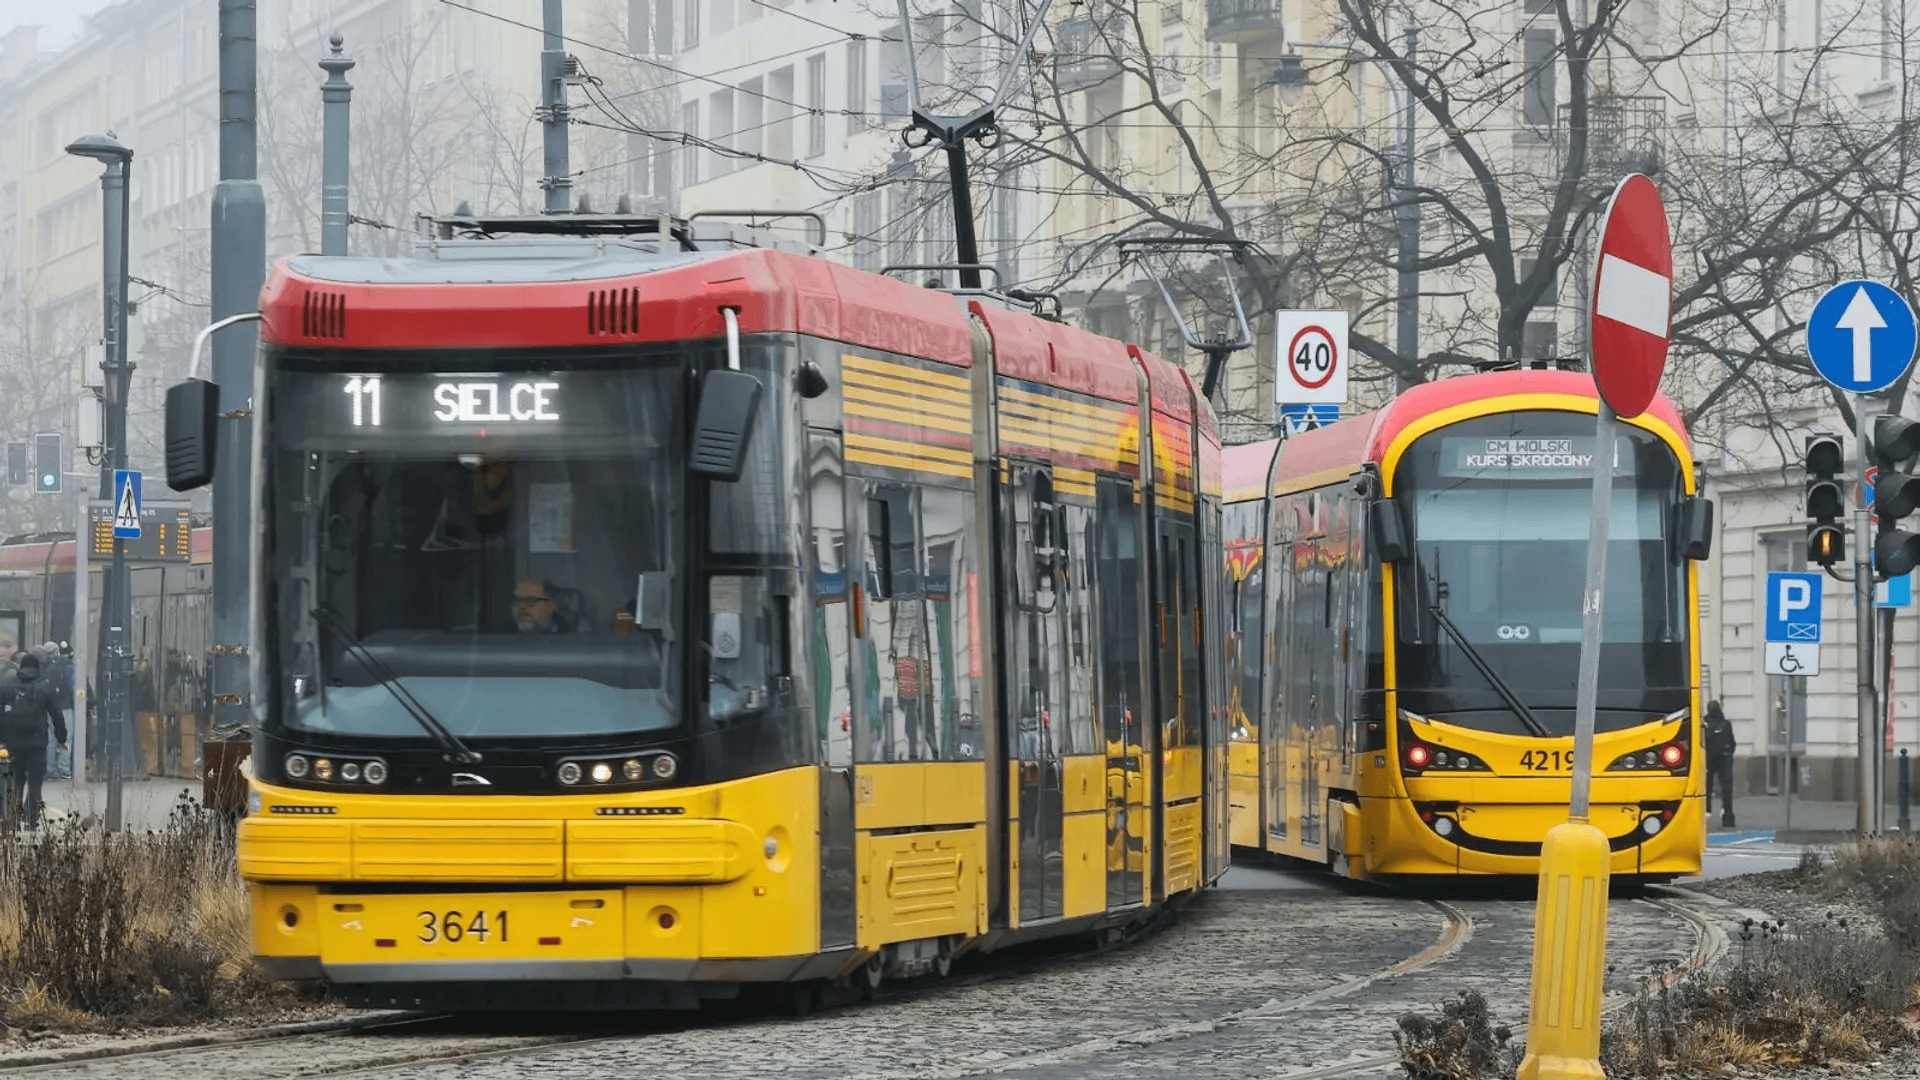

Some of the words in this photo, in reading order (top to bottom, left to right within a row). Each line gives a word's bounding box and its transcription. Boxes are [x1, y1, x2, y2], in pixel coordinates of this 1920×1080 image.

[1296, 342, 1330, 371] 40
[343, 376, 381, 426] 11
[433, 382, 560, 422] SIELCE
[1466, 455, 1508, 468] KURS
[1486, 441, 1509, 453] CM
[1515, 441, 1571, 453] WOLSKI
[1779, 578, 1811, 621] P
[1520, 750, 1575, 771] 4219
[416, 910, 510, 945] 3641
